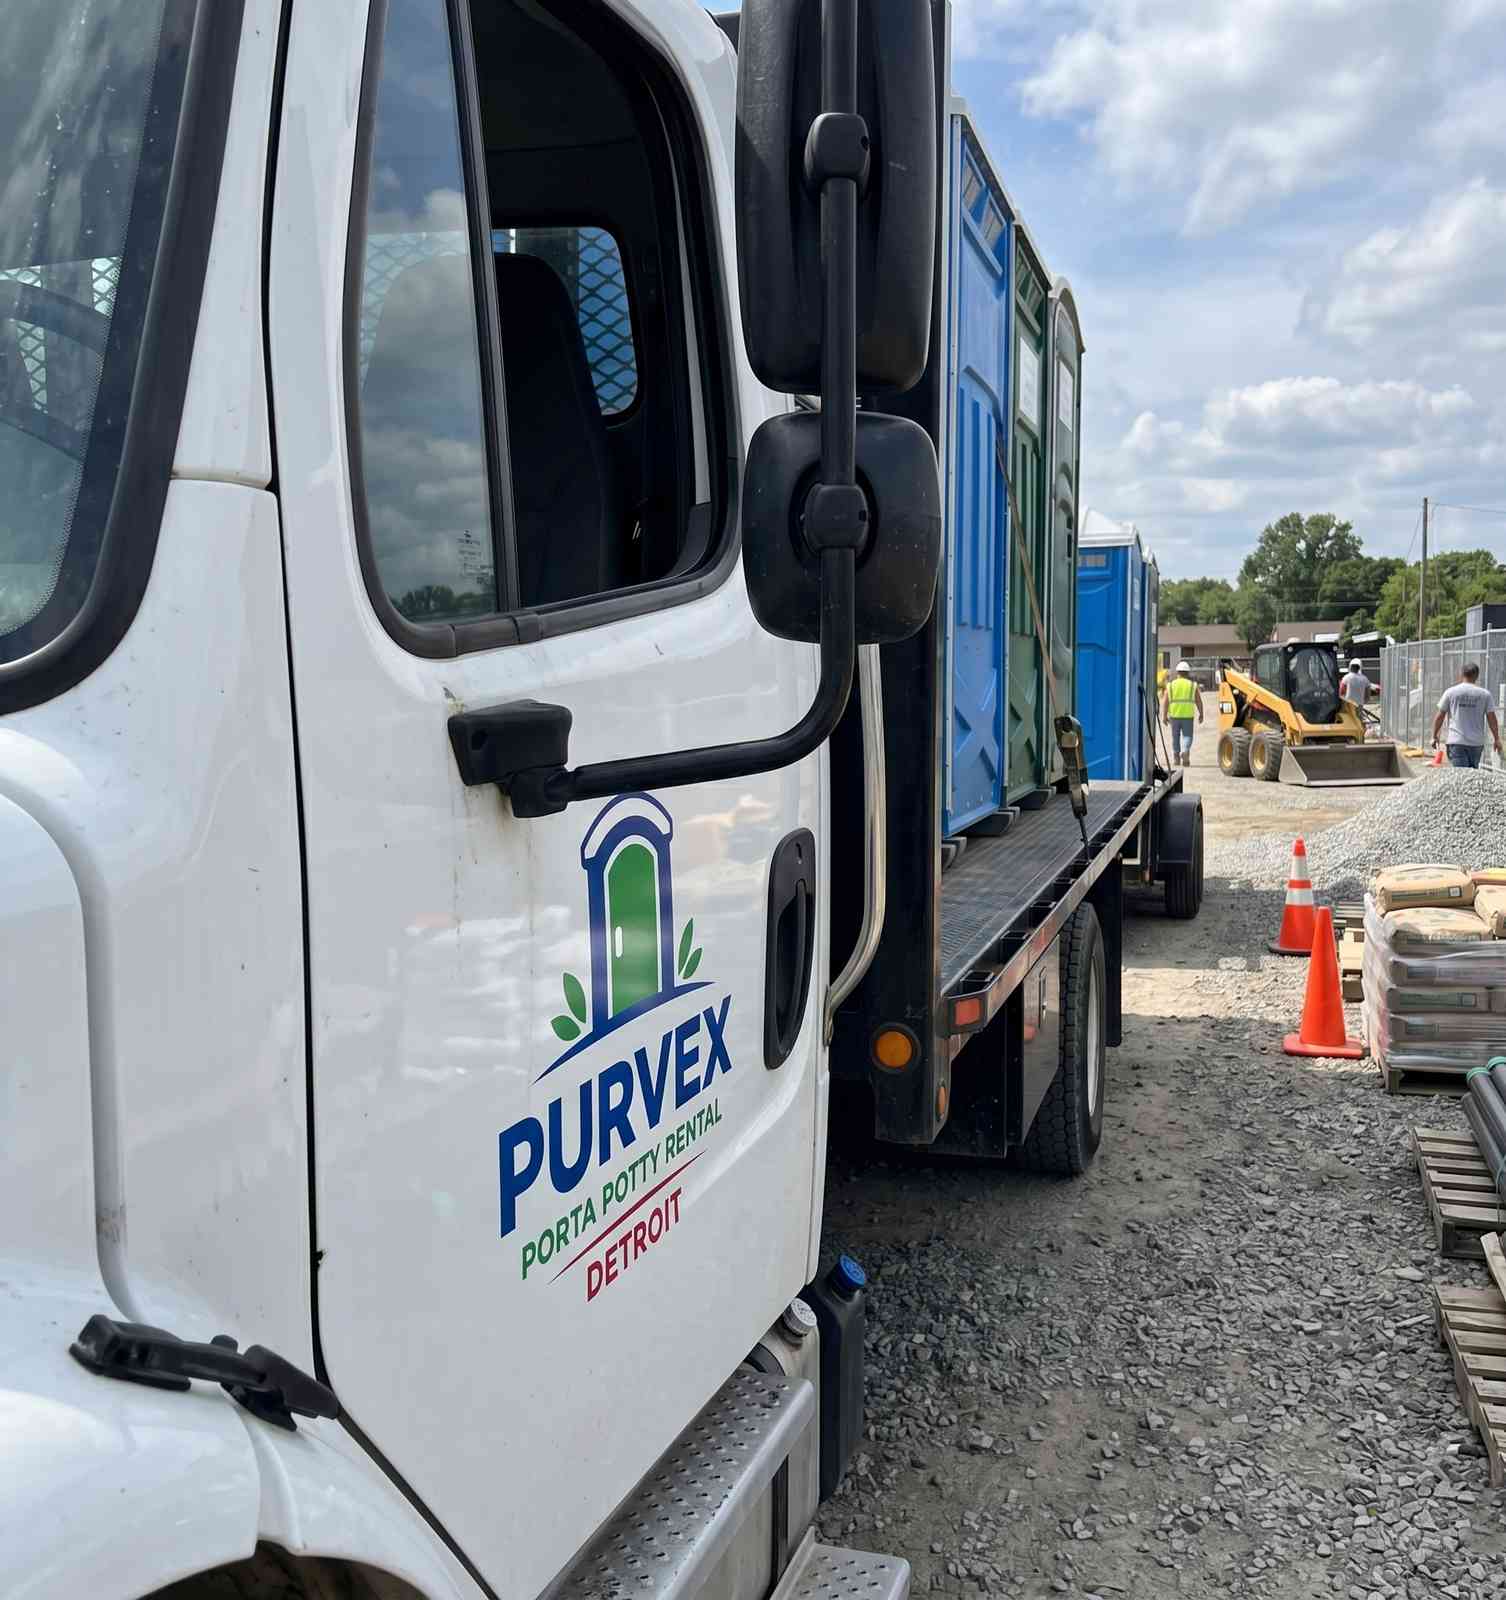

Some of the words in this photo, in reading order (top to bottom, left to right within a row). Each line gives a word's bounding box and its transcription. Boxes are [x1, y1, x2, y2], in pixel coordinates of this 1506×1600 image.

[499, 994, 732, 1239] PURVEX
[521, 1197, 597, 1281] PORTA
[602, 1143, 661, 1216] POTTY
[665, 1097, 723, 1164] RENTAL
[586, 1187, 683, 1302] DETROIT
